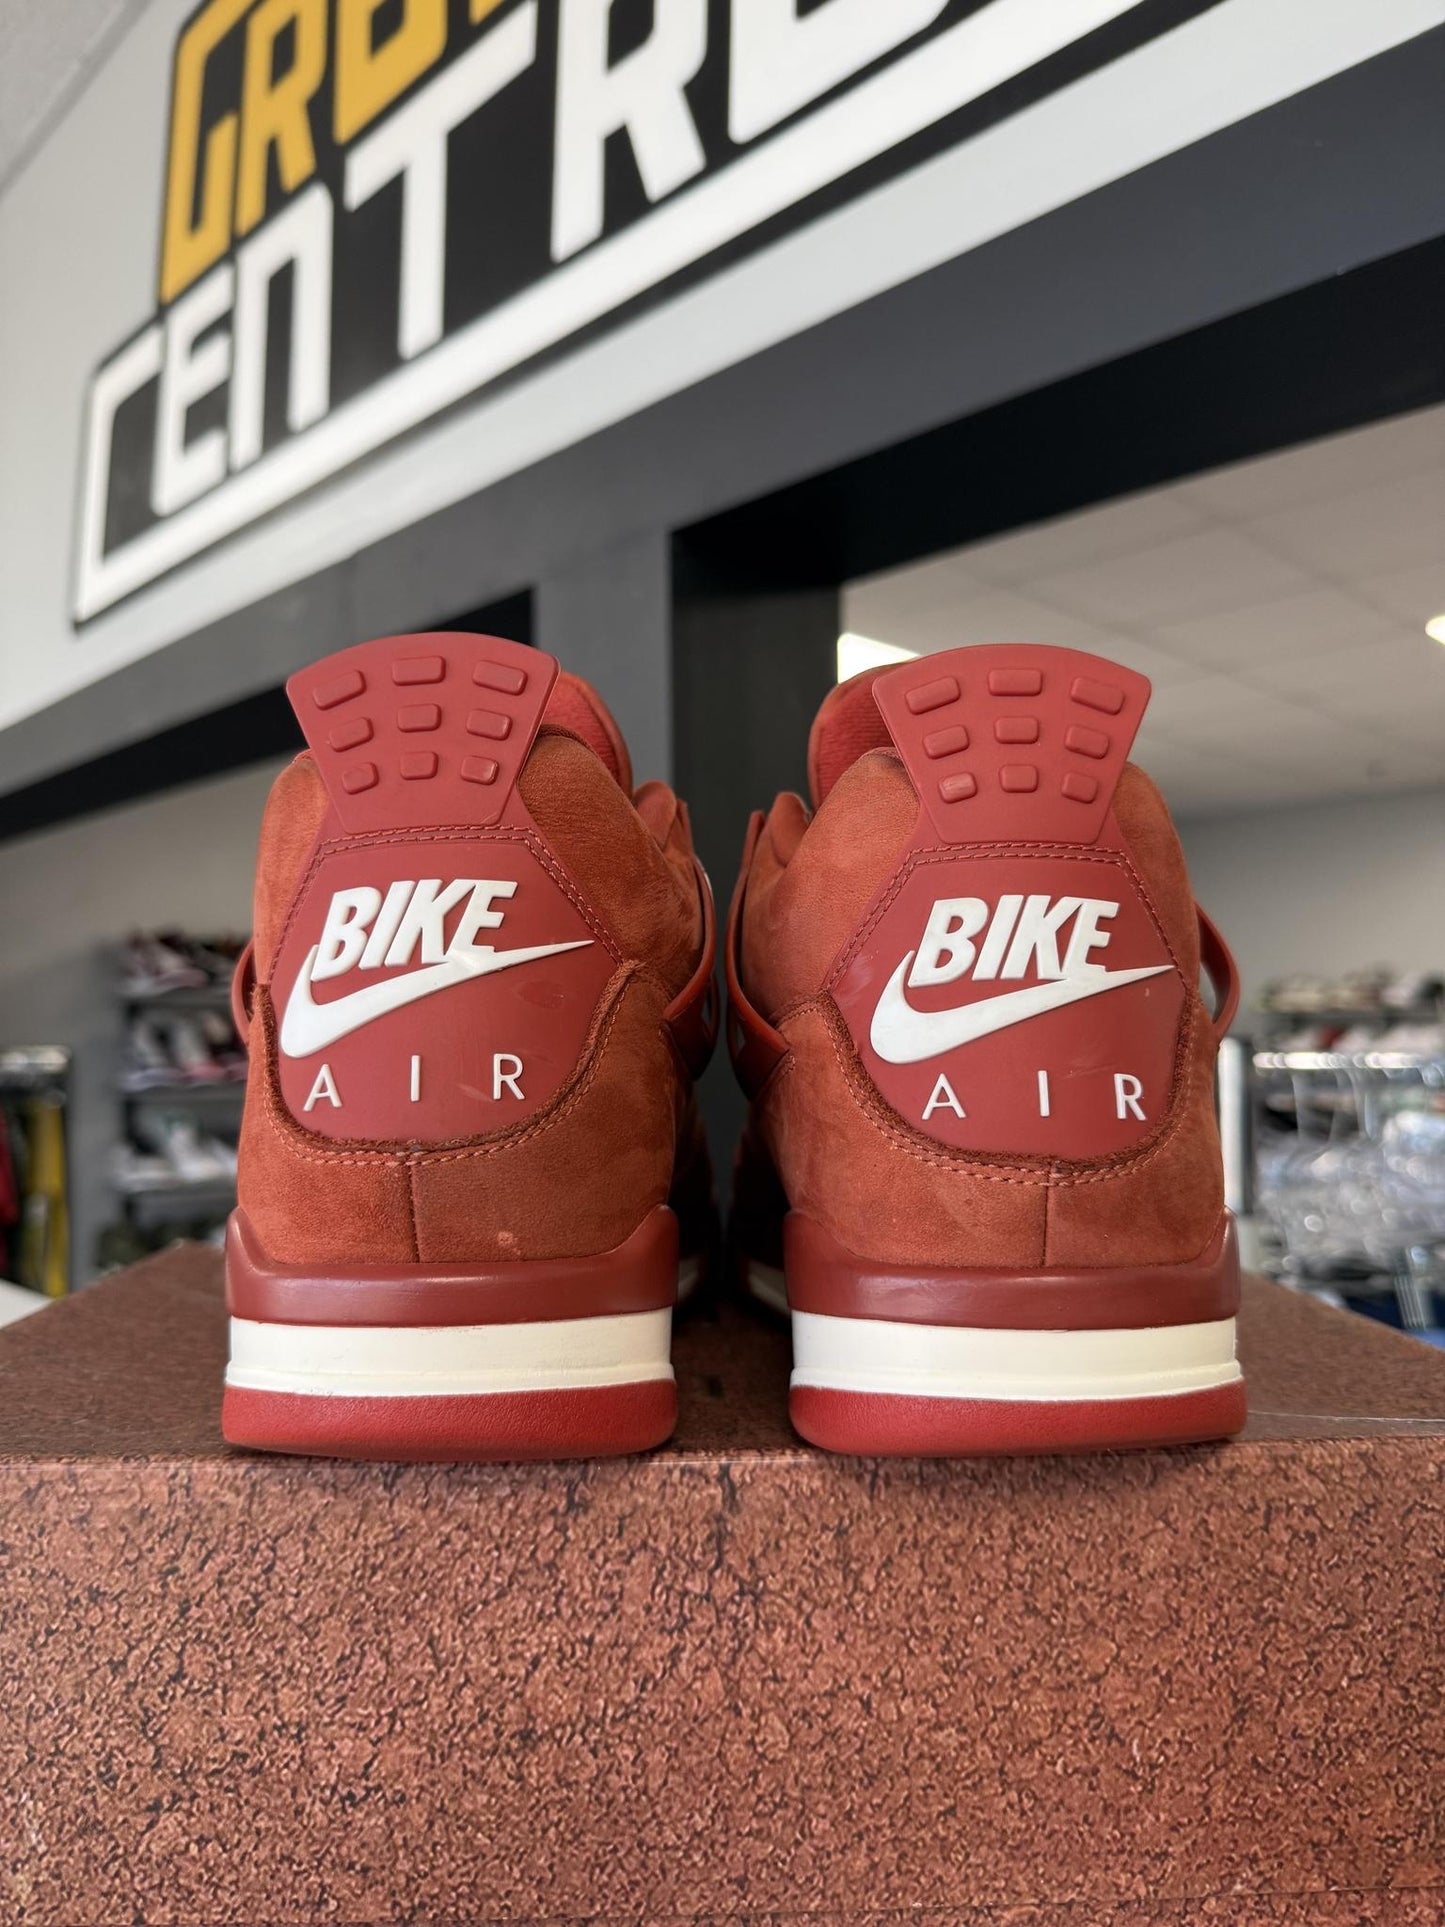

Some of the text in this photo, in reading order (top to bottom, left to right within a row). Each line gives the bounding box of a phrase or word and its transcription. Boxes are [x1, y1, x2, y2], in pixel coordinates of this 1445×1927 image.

[310, 878, 519, 982] BIKE
[908, 894, 1120, 988] BIKE
[303, 1053, 525, 1112] AIR
[921, 1069, 1147, 1121] AIR
